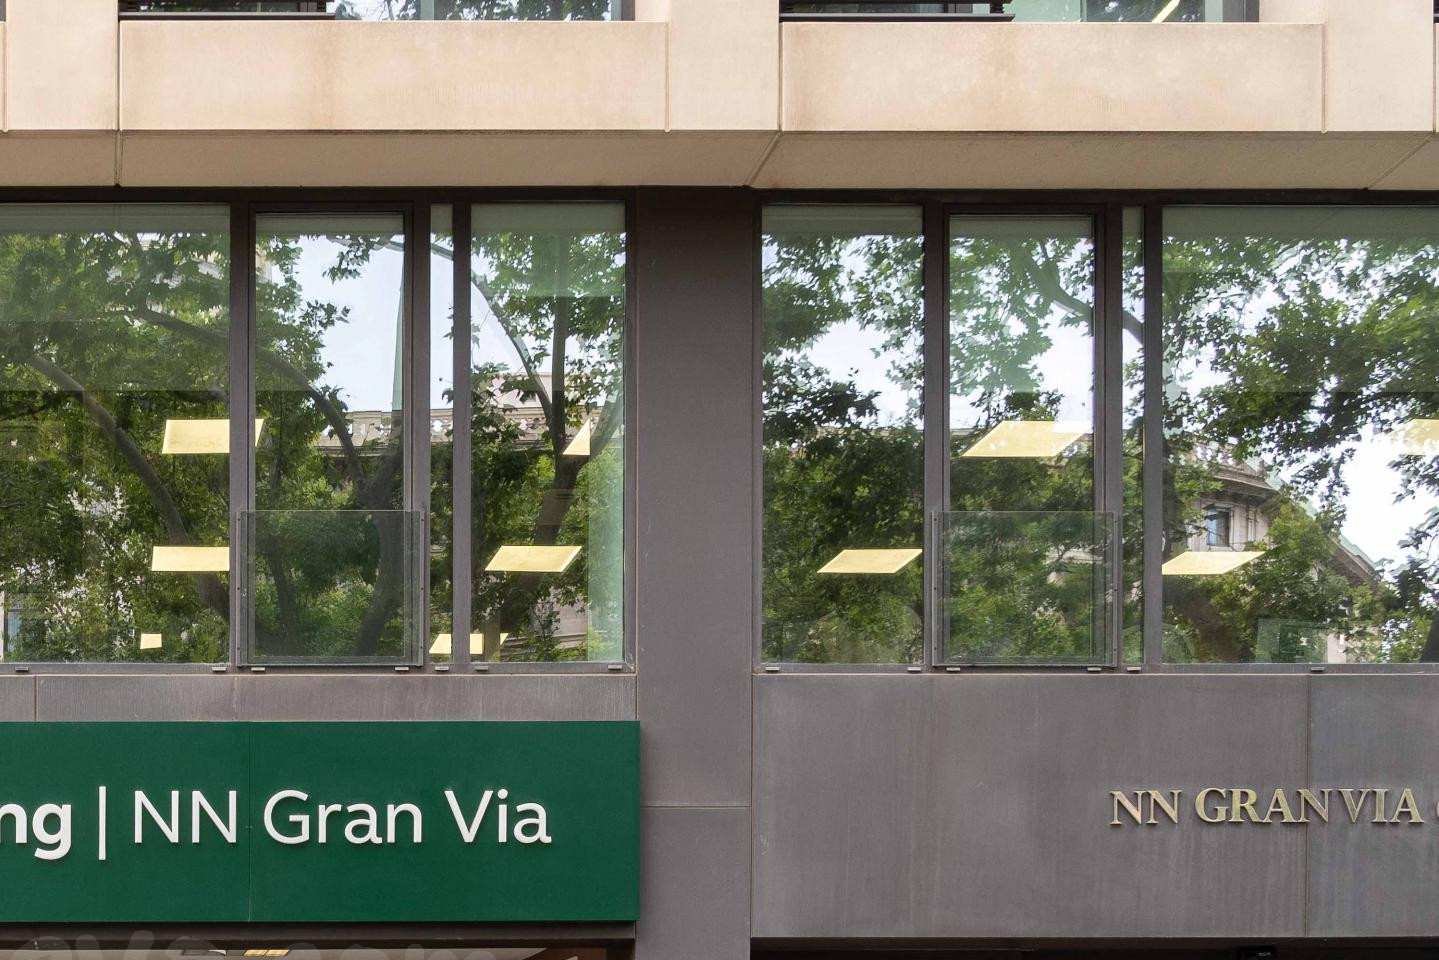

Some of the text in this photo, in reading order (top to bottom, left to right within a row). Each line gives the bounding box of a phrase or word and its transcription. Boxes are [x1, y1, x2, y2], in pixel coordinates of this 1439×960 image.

[134, 789, 237, 844] NN
[263, 789, 423, 845] Gran
[444, 788, 552, 845] Via
[1110, 789, 1182, 825] NN
[1195, 787, 1333, 823] GRAN
[1338, 788, 1424, 823] VIA
